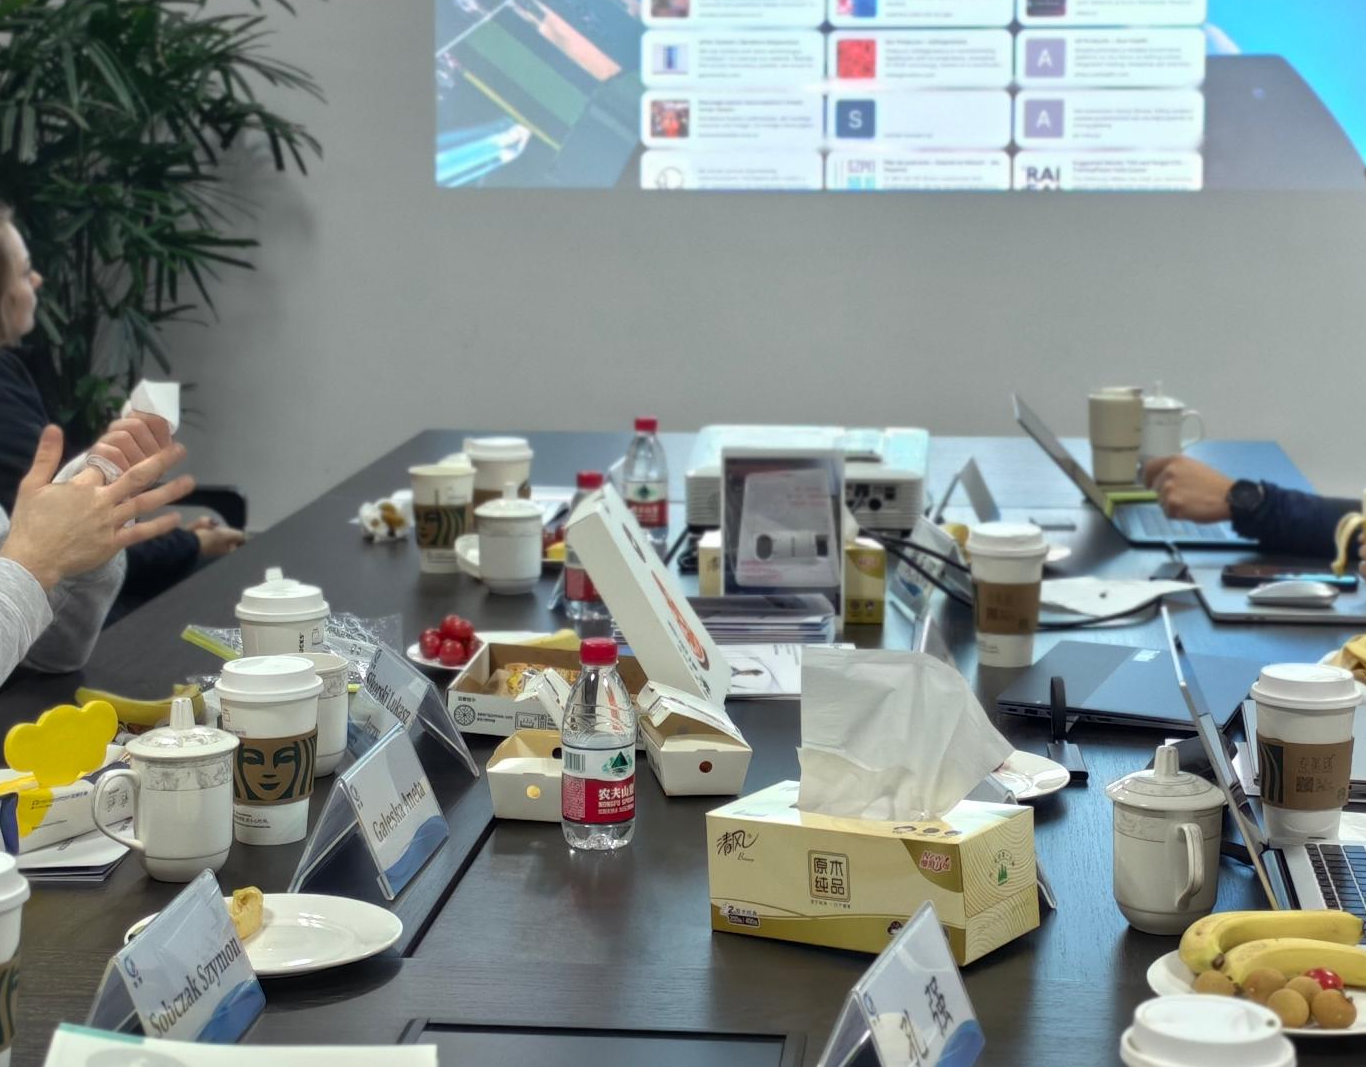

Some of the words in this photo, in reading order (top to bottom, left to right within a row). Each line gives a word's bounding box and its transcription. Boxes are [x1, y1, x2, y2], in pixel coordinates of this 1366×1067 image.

[1037, 49, 1053, 67] A
[849, 110, 863, 129] S
[1036, 110, 1052, 129] A
[813, 857, 843, 876] 原木
[815, 876, 845, 895] 纯品
[149, 976, 203, 1039] Sobczak
[196, 936, 241, 992] Szymon
